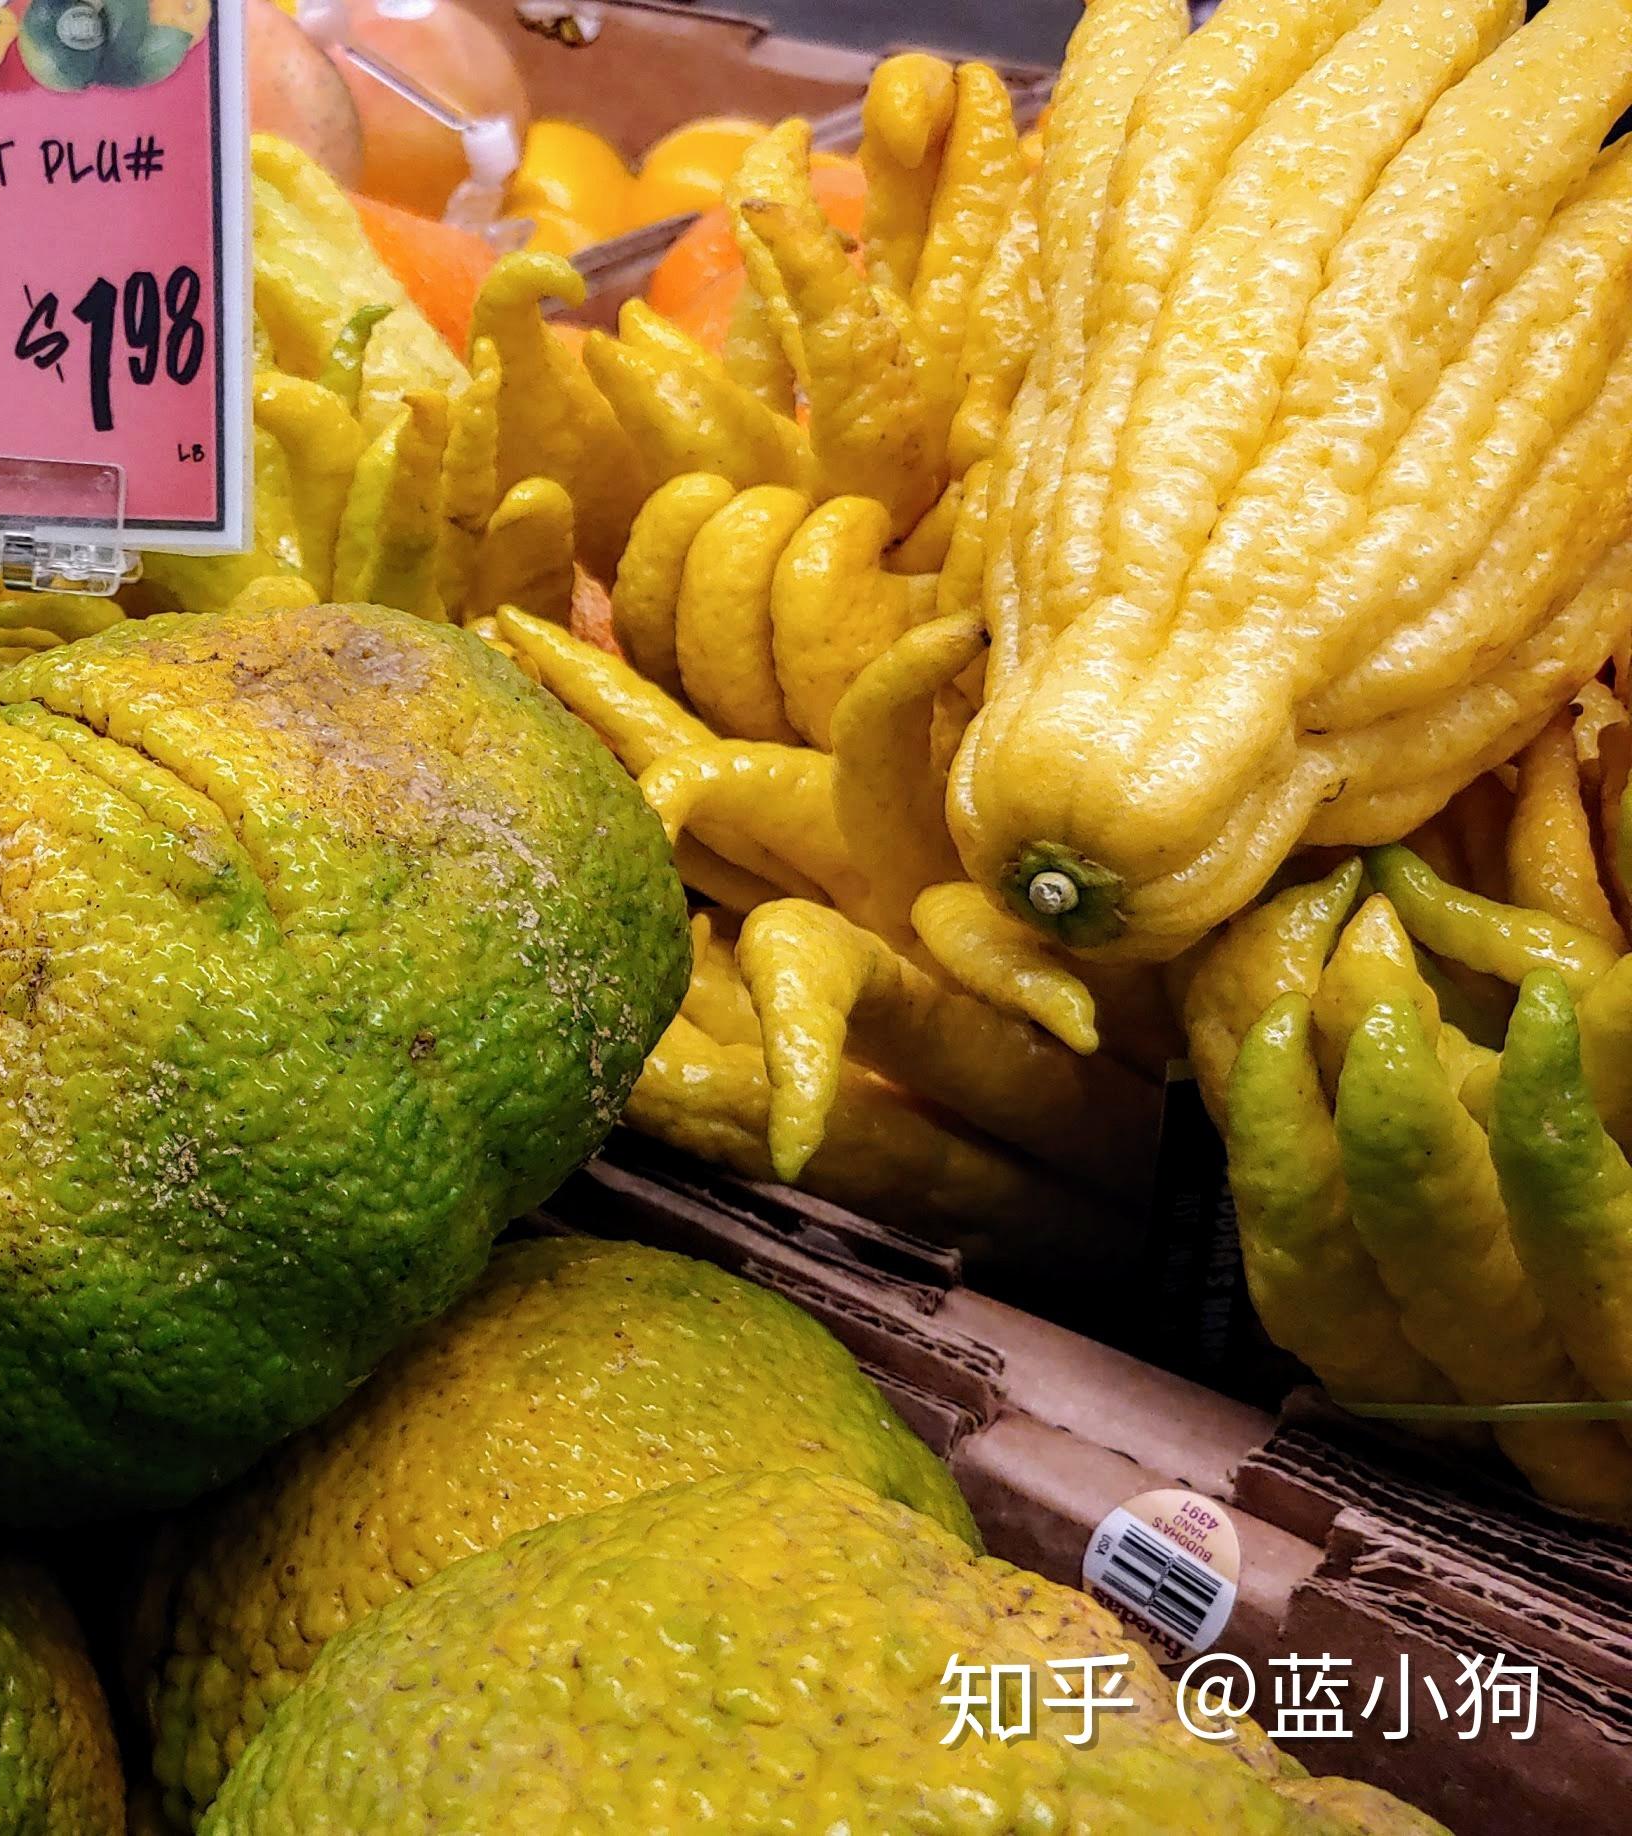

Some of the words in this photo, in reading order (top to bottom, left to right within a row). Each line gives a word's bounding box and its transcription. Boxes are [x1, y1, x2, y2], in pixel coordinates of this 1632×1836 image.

[42, 136, 165, 184] PLU#
[177, 443, 205, 462] LB
[1172, 1514, 1208, 1543] HAND
[1180, 1500, 1220, 1530] 4391
[1095, 1533, 1113, 1556] USA
[1151, 1516, 1213, 1563] BUDDHA'S
